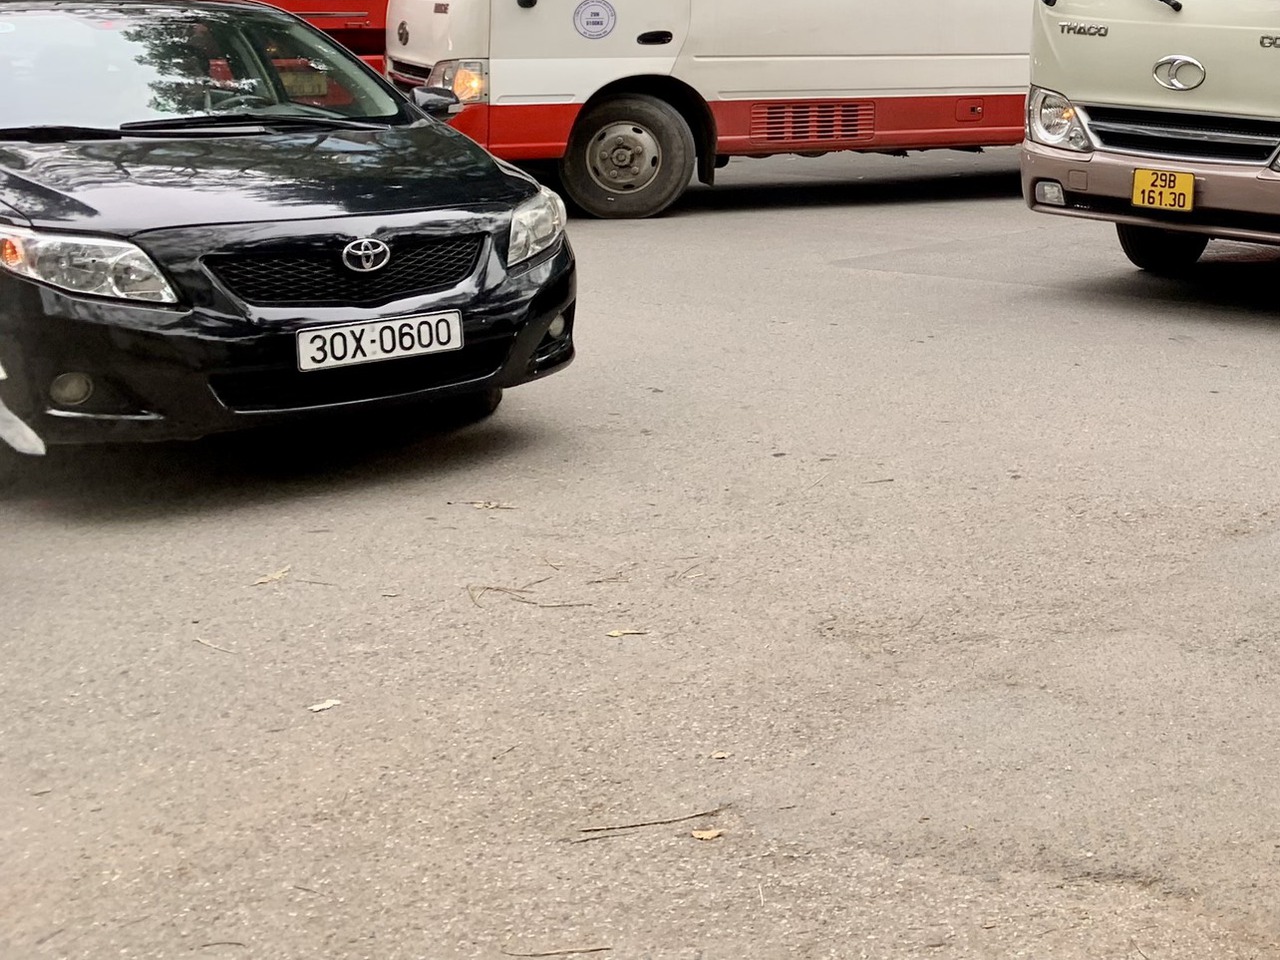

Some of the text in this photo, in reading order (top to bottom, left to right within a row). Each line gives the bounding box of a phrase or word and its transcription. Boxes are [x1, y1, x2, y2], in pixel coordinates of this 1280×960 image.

[1058, 21, 1109, 37] THACO
[1150, 172, 1177, 189] 29B
[1140, 189, 1186, 208] 161.30
[309, 318, 452, 364] 30X-0600
